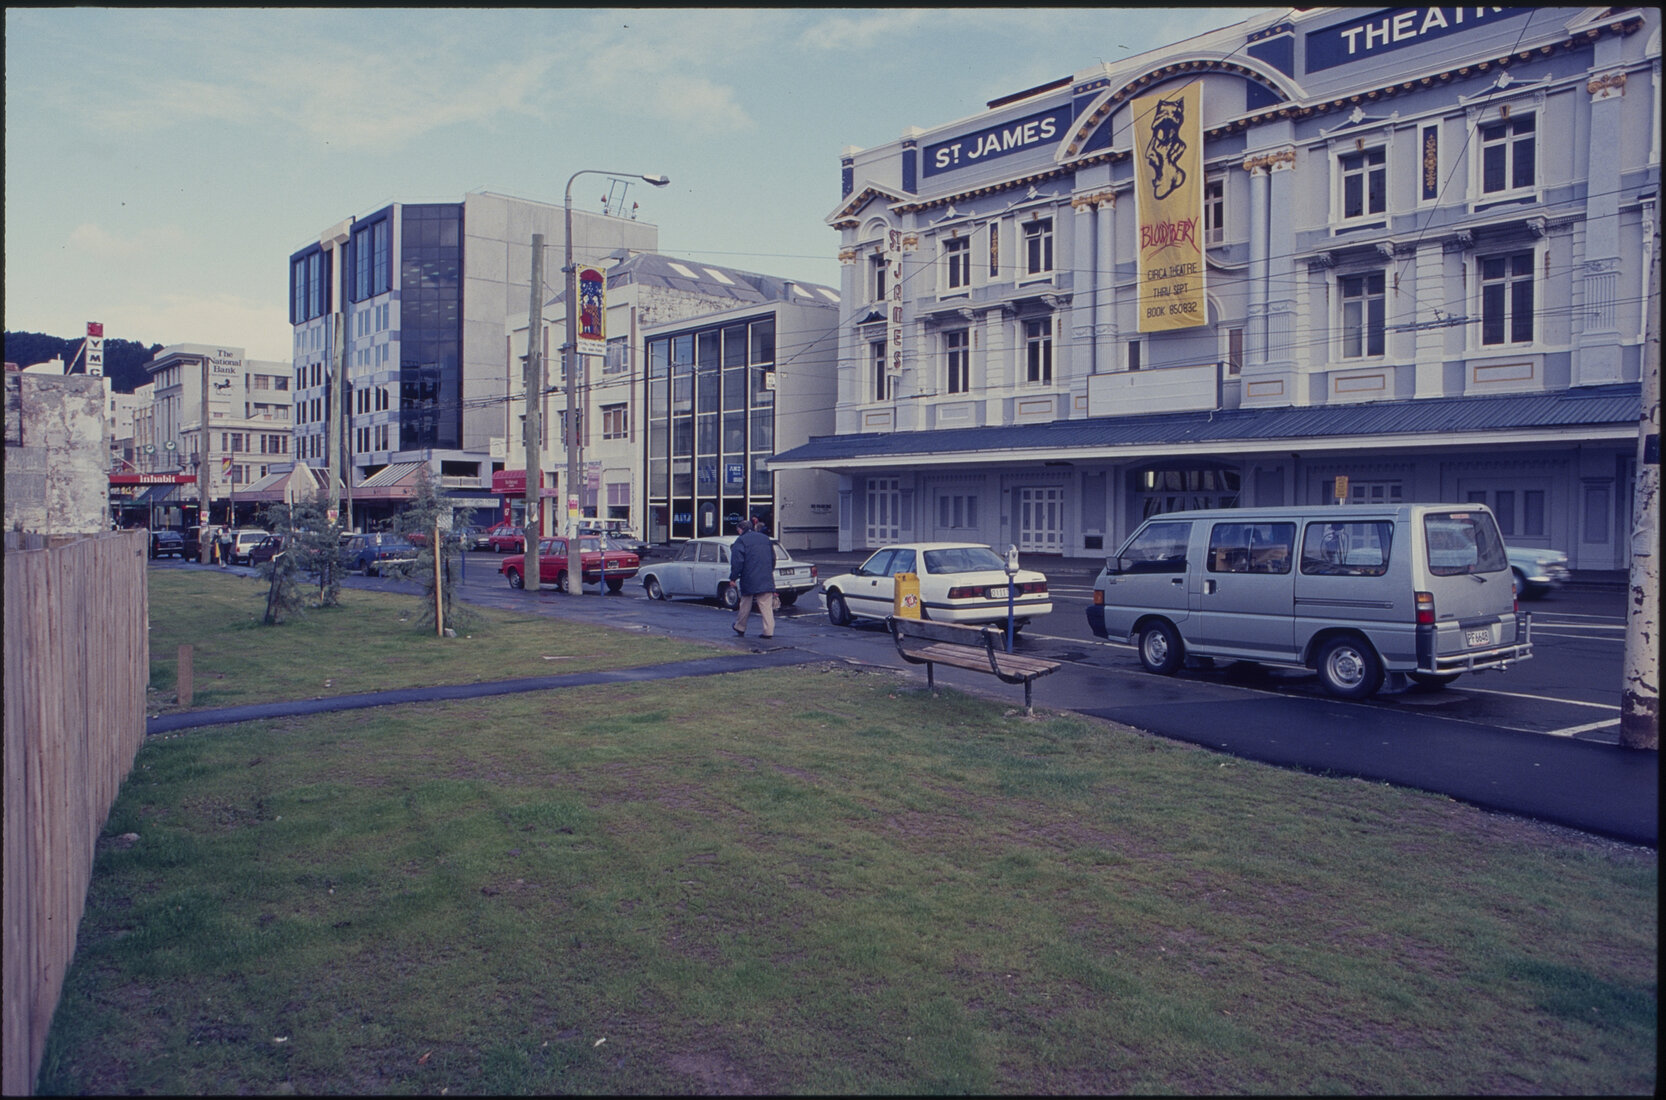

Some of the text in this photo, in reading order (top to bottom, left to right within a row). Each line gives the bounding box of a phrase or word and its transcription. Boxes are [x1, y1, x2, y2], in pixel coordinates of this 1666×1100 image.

[968, 117, 1056, 159] JAMES
[1147, 262, 1198, 281] CIRCA THEATRE
[1173, 283, 1188, 295] SEPT
[1147, 306, 1165, 318] BOOK
[217, 349, 233, 358] The
[214, 365, 236, 374] Bank
